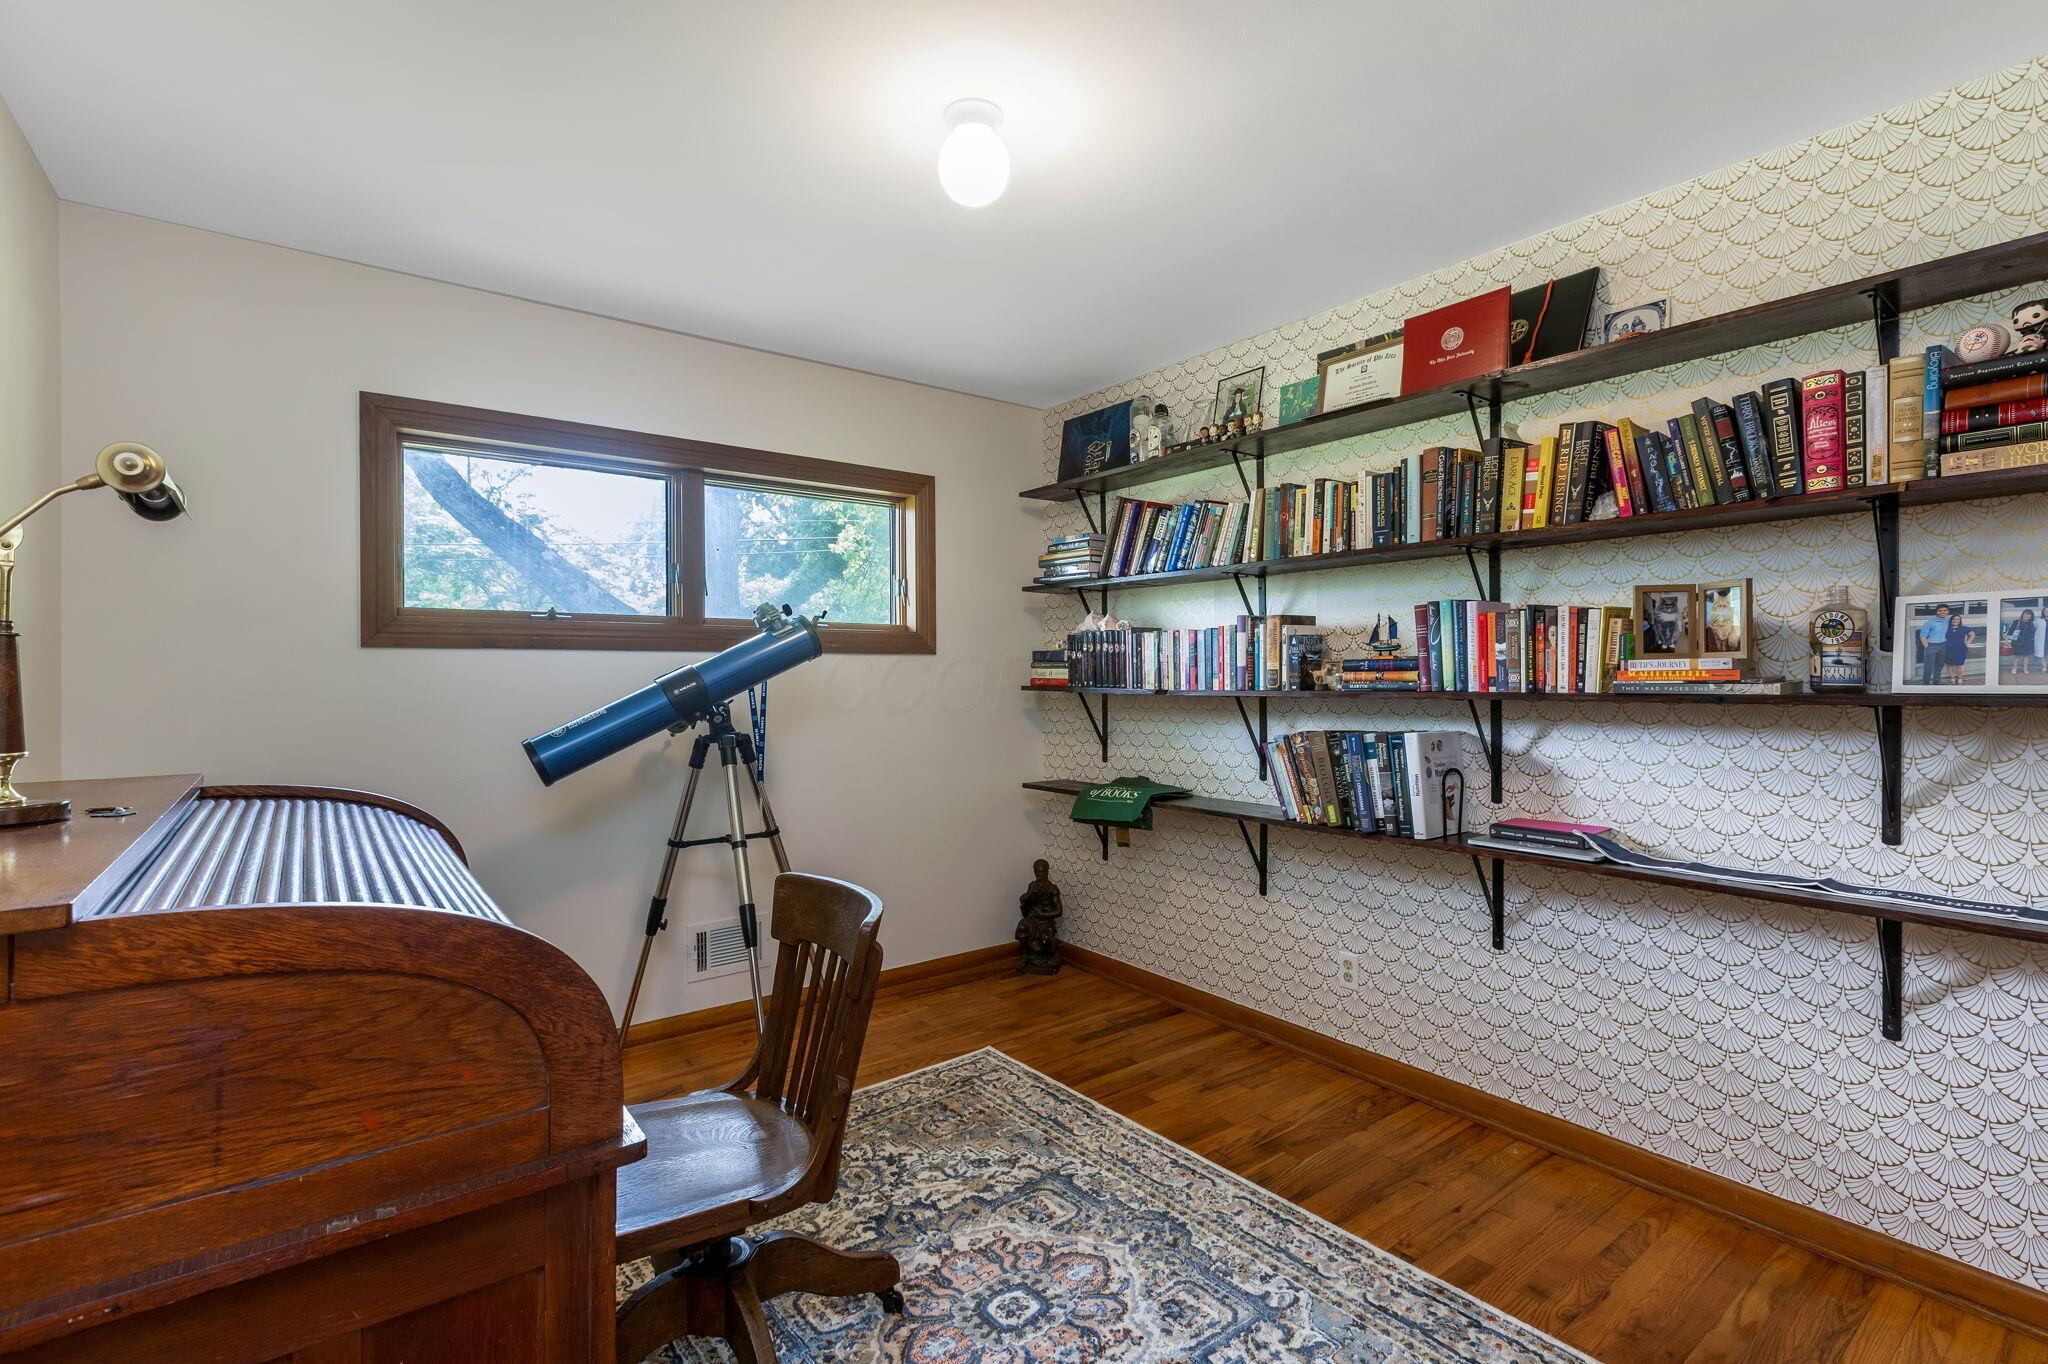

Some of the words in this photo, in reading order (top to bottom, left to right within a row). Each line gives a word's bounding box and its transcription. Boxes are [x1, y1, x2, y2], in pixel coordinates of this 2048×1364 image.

[1335, 366, 1346, 374] The
[1926, 351, 1942, 390] Bicycling
[1950, 371, 1975, 379] American
[1976, 364, 2014, 375] Supernatural
[1739, 394, 1754, 420] TERRY
[1744, 420, 1758, 452] BROOKS
[2007, 441, 2048, 456] WOR
[1559, 448, 1570, 470] RED
[1572, 441, 1582, 479] BRINGER
[1580, 439, 1590, 468] LIGHT
[1590, 424, 1602, 479] BRINGER
[1708, 446, 1720, 472] LEGEND
[2000, 452, 2048, 468] HISTO
[1483, 456, 1491, 492] BRINGER
[1490, 455, 1498, 480] LIGHT
[1508, 456, 1518, 479] DARK
[1508, 480, 1517, 497] AGE
[1554, 475, 1566, 512] RISING
[1820, 612, 1849, 623] SEDONA
[1656, 660, 1687, 669] JOURNEY
[679, 681, 697, 692] MEADE
[1298, 748, 1308, 772] Organic
[1306, 774, 1316, 804] Chemistry
[1318, 756, 1333, 804] BIOLOGY
[1090, 789, 1100, 798] of
[1101, 788, 1138, 798] BOOKS
